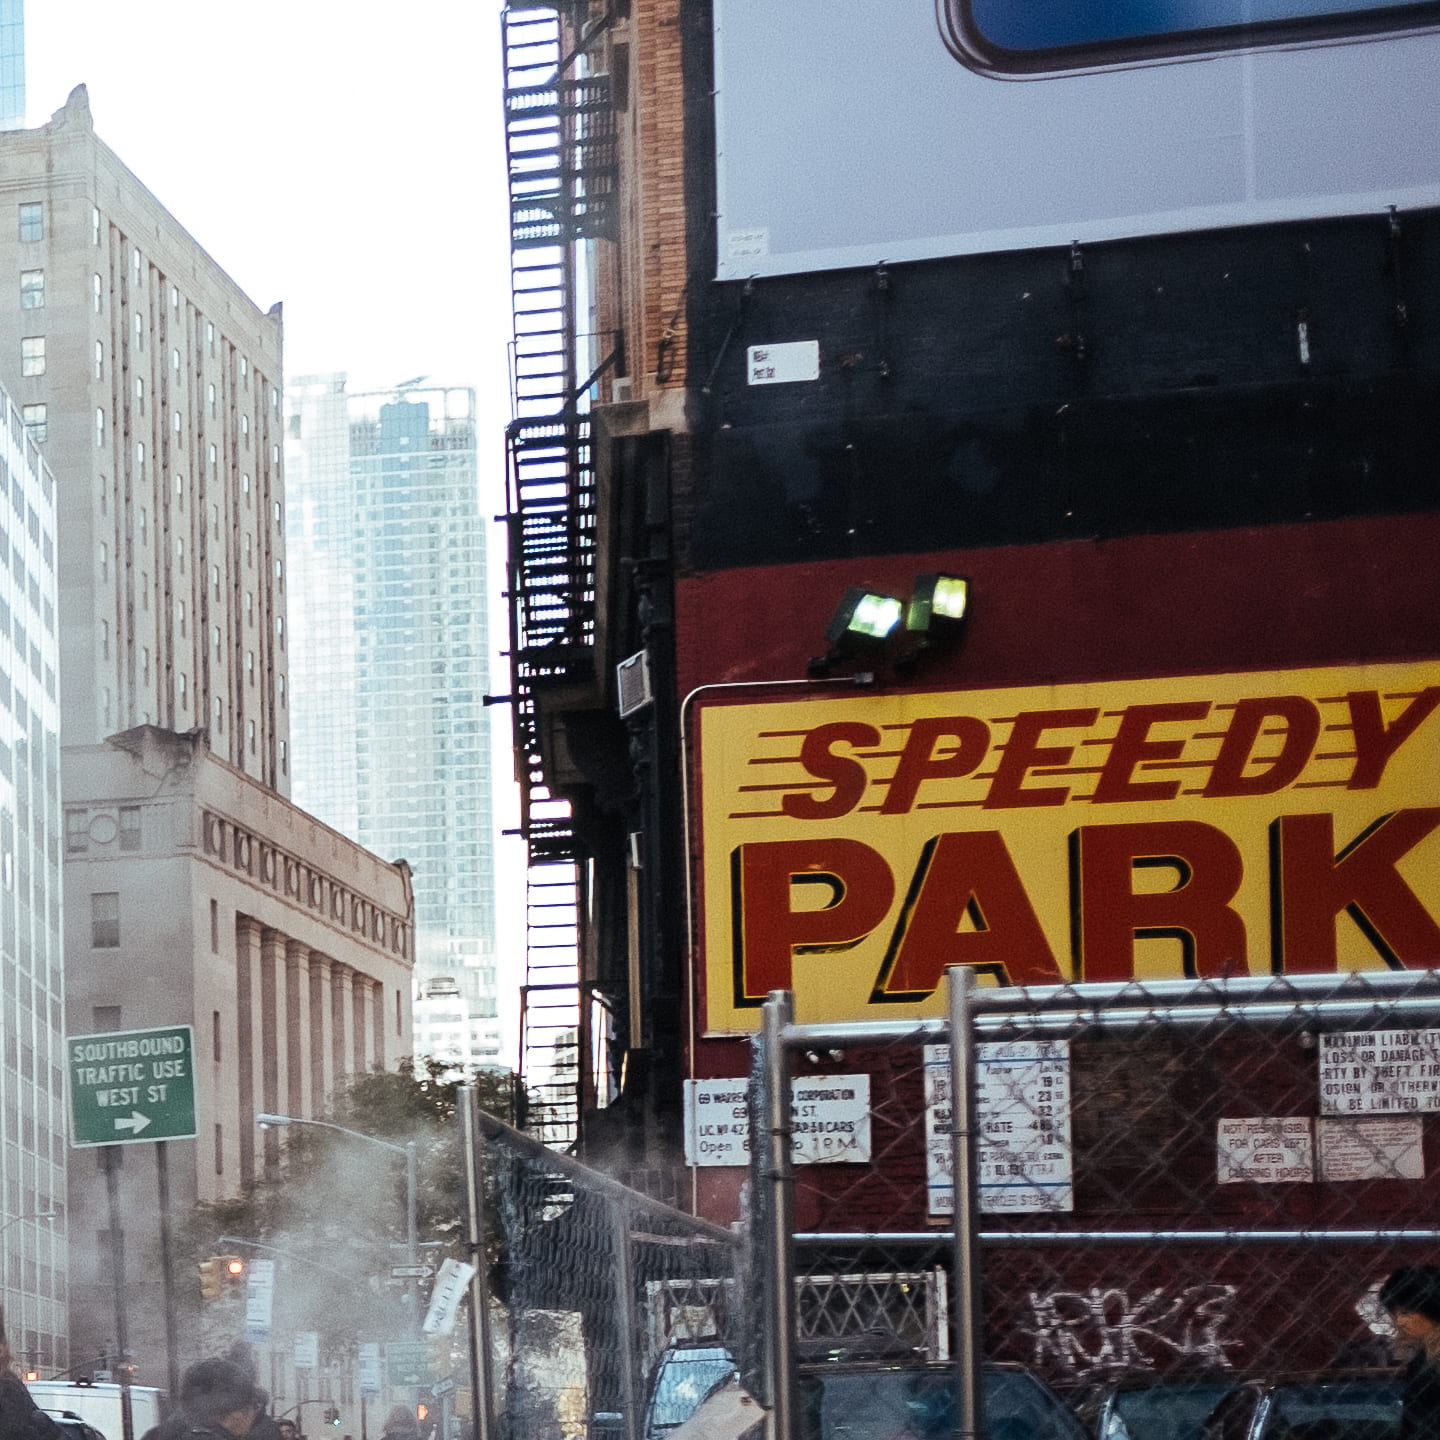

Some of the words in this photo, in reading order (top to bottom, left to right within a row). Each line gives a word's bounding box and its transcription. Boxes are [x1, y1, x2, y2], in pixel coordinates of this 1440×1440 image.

[780, 685, 1440, 820] SPEEDY
[730, 806, 1440, 1009] PARK
[1324, 1034, 1376, 1048] MAXIMUM
[74, 1036, 184, 1062] SOUTHBOUND
[1325, 1051, 1356, 1064] LOSS
[1361, 1051, 1376, 1063] OR
[1381, 1049, 1426, 1062] DAMAGE
[76, 1063, 145, 1085] TRAFFIC
[153, 1060, 184, 1079] USE
[1353, 1066, 1368, 1079] BY
[96, 1087, 139, 1107] WEST
[147, 1085, 167, 1103] ST
[1348, 1098, 1363, 1110] BE
[1370, 1097, 1419, 1110] LIMITED
[1223, 1124, 1243, 1134] NOT
[699, 1140, 733, 1154] Open
[1229, 1139, 1248, 1149] FOR
[1253, 1138, 1281, 1149] CARS
[1284, 1138, 1308, 1148] LEFT
[1253, 1153, 1284, 1163] AFTER
[1228, 1167, 1271, 1178] CLOSING
